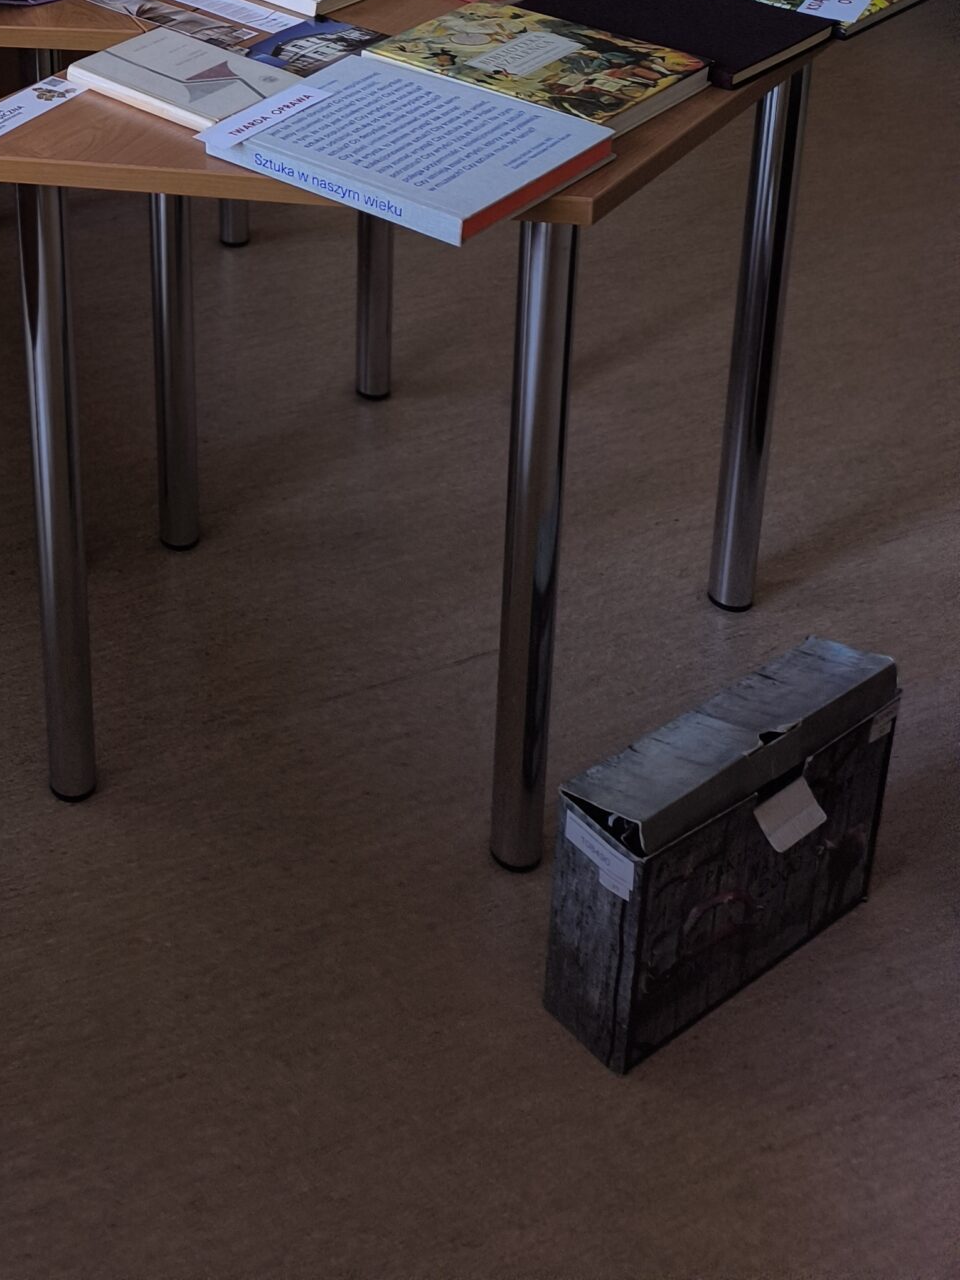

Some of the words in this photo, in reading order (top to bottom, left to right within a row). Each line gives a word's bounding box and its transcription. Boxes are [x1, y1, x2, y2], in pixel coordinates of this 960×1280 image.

[228, 115, 272, 138] TWARDA
[271, 93, 315, 117] OPRAWA
[254, 152, 296, 178] Sztuka
[297, 170, 310, 182] w
[311, 175, 361, 203] naszym
[363, 190, 404, 218] wieku
